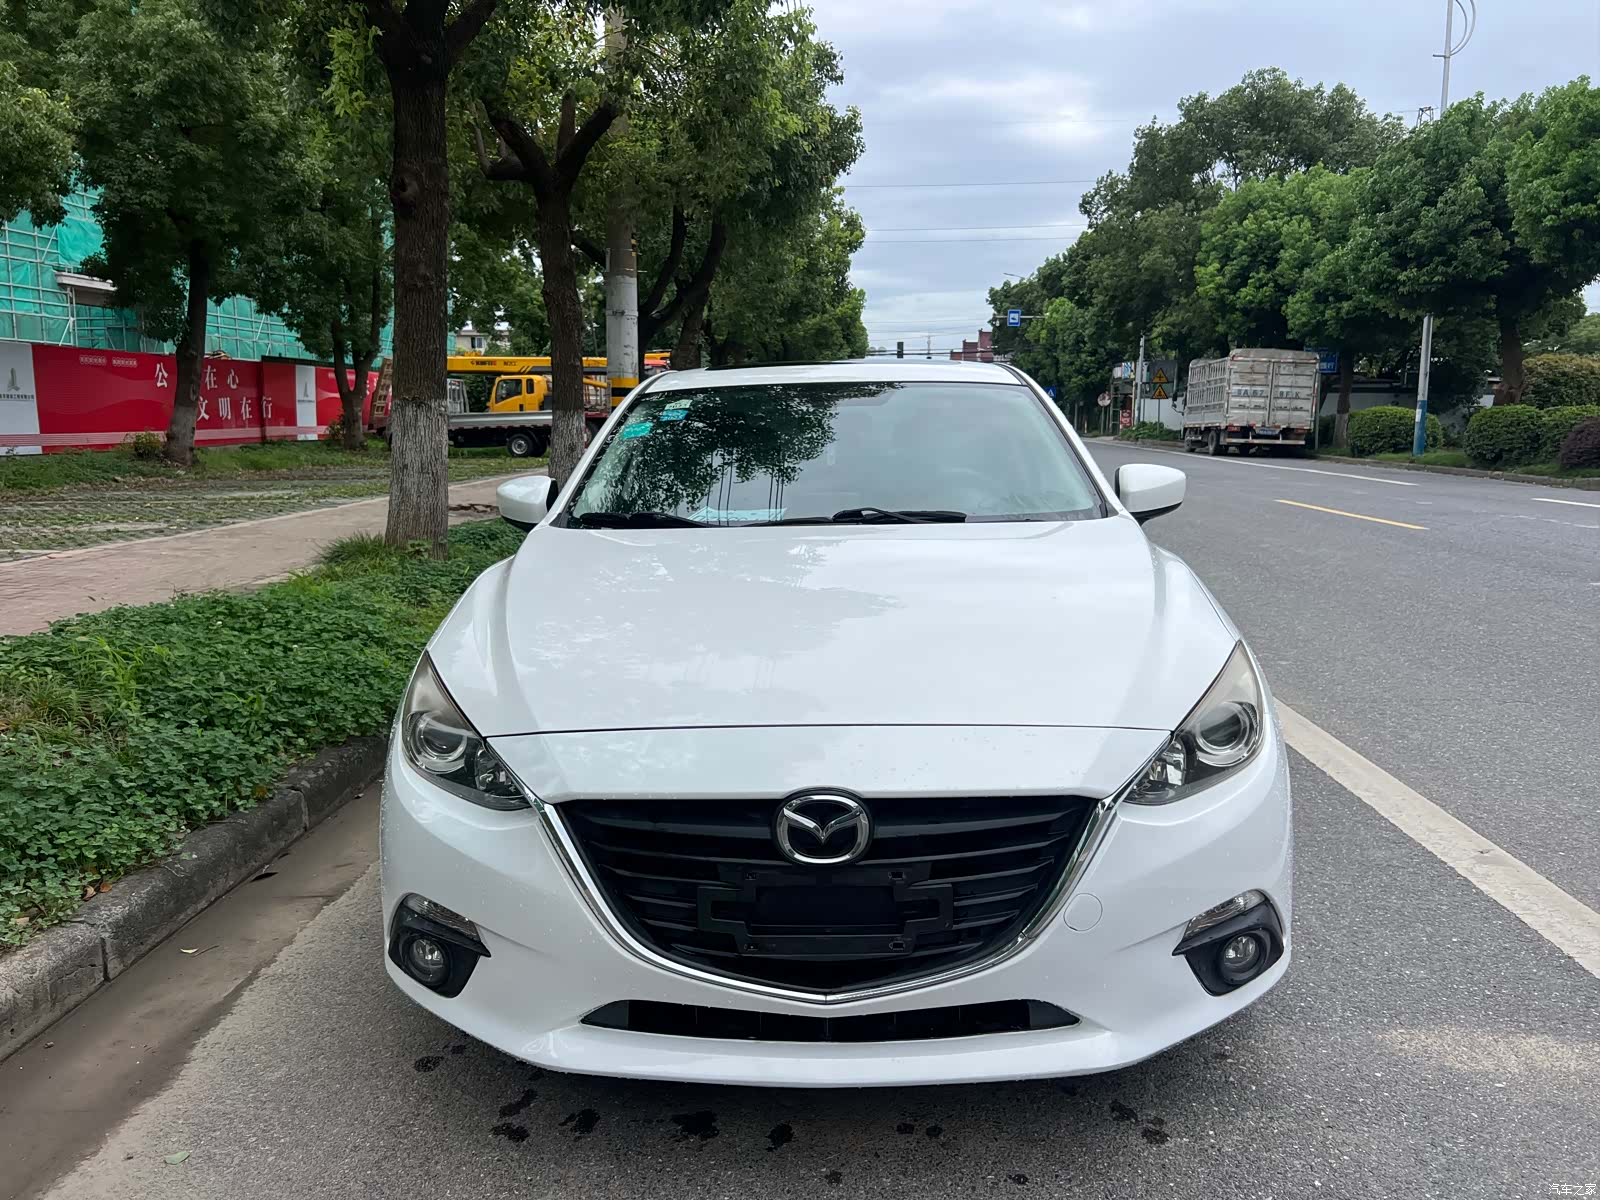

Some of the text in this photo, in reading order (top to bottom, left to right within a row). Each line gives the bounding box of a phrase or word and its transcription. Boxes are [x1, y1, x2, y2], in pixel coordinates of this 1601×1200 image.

[155, 362, 239, 390] 公在心
[197, 396, 272, 420] 文明在行
